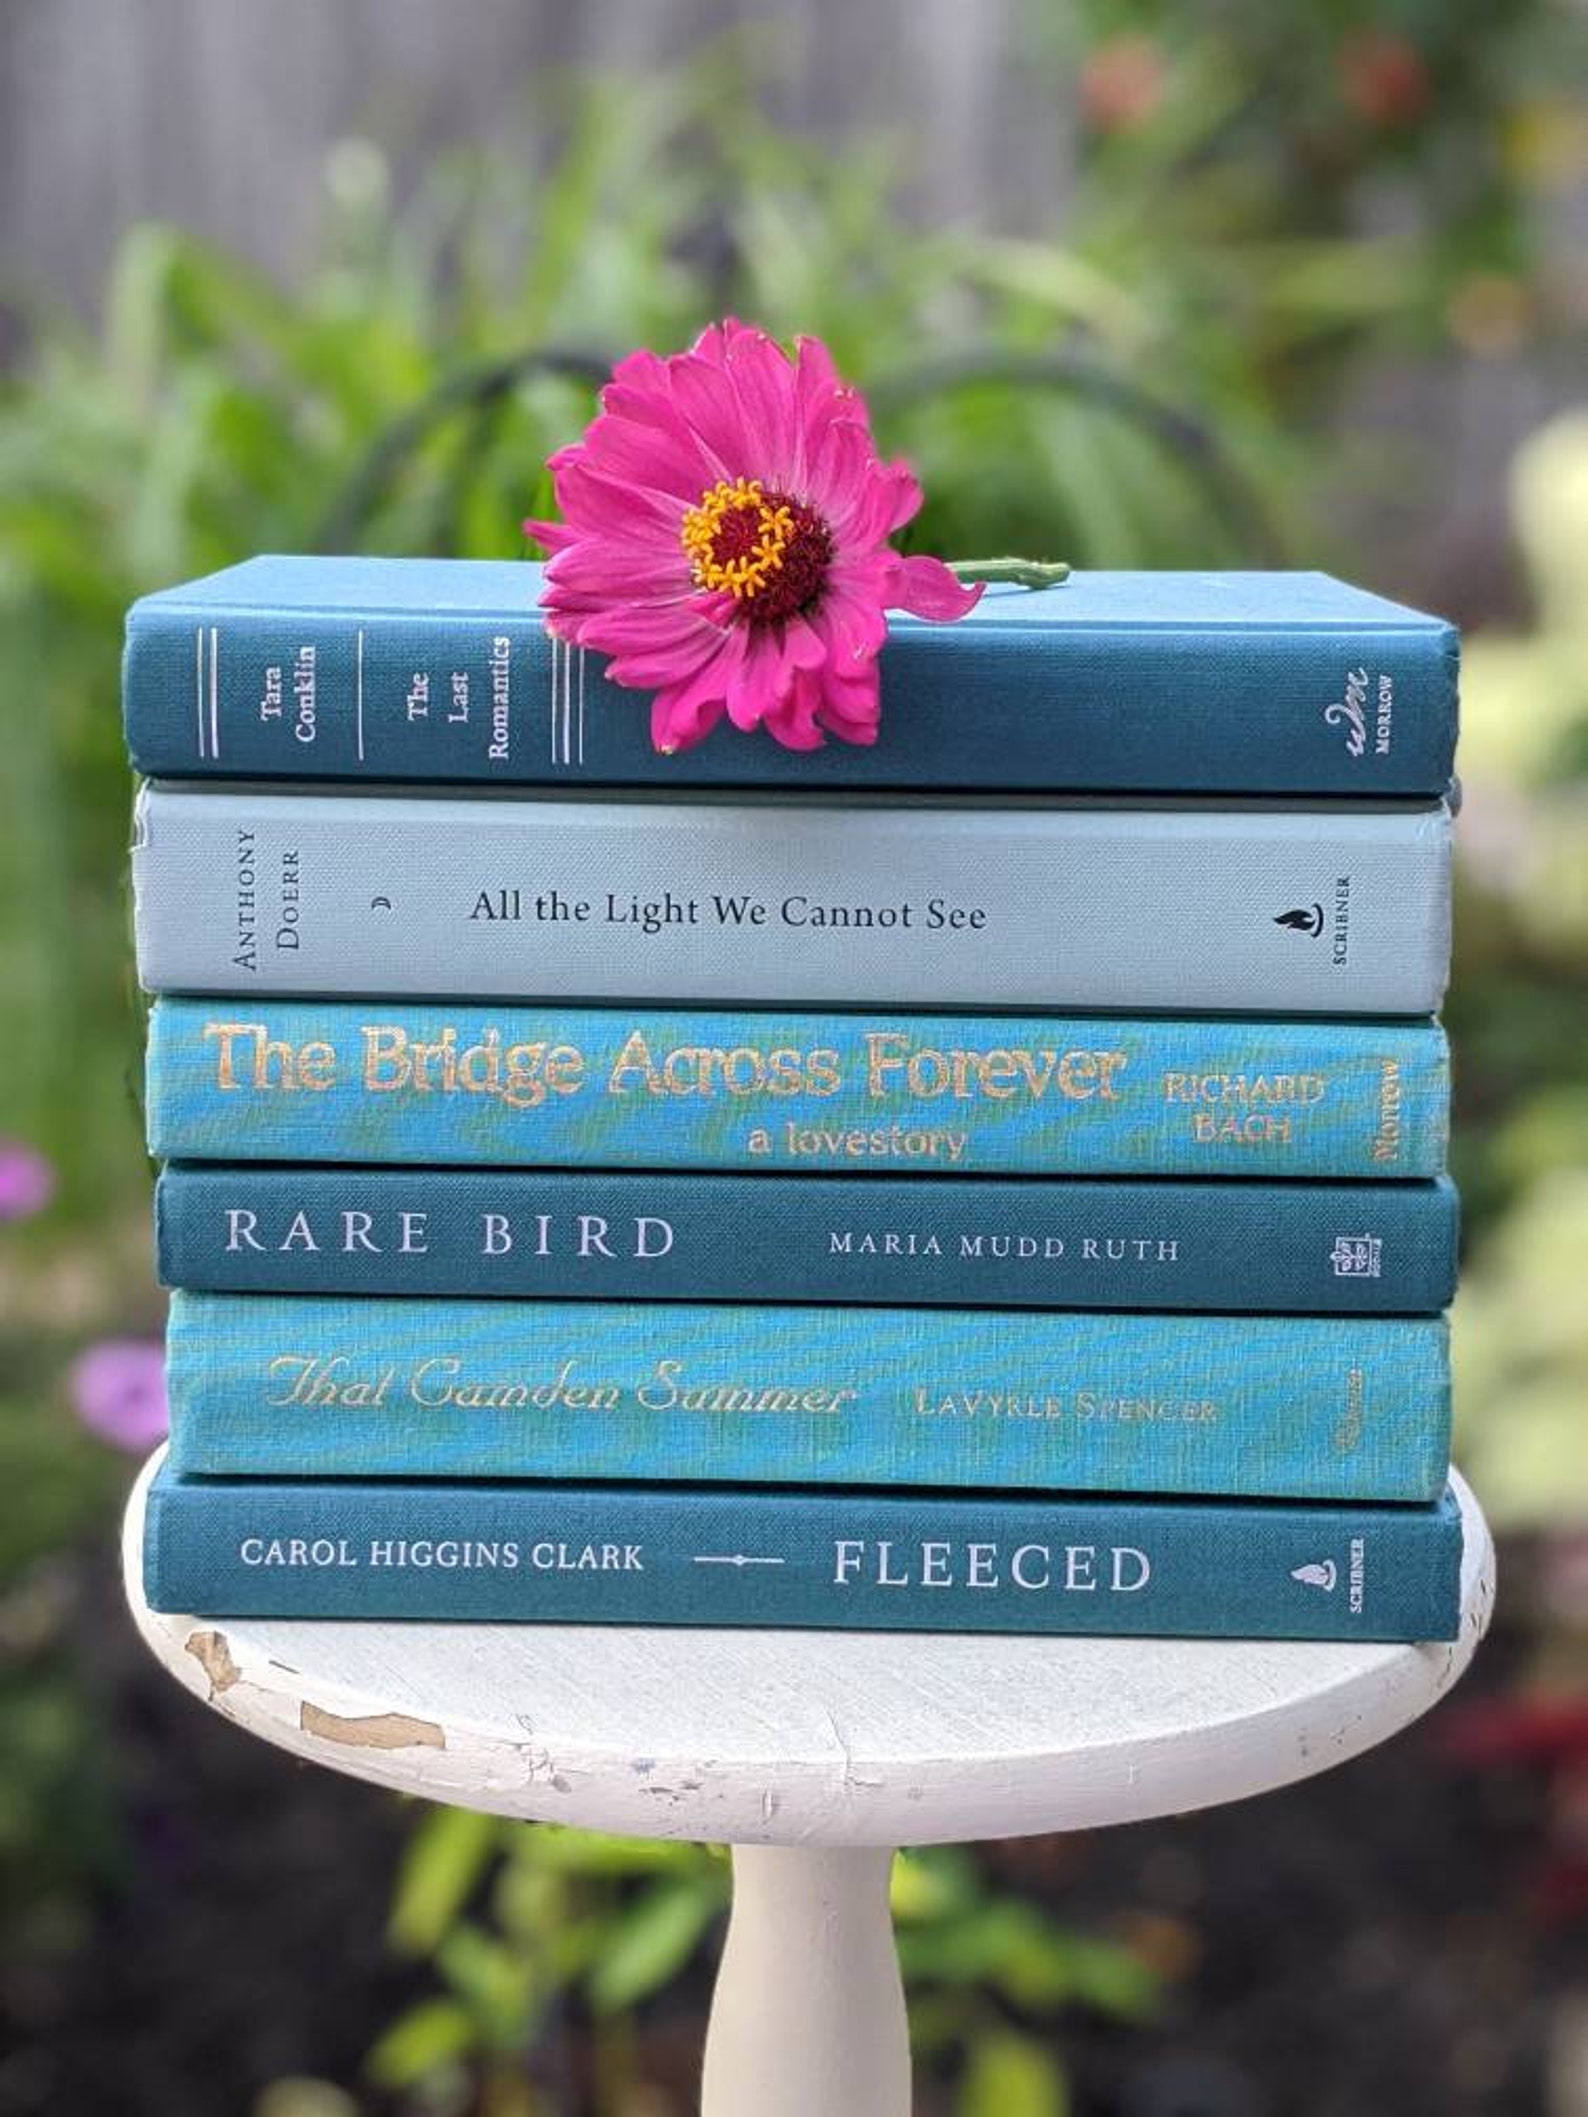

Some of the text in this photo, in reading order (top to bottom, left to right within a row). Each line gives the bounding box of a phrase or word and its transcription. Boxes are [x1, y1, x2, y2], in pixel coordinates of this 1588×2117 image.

[260, 666, 282, 721] Tara
[295, 646, 316, 742] Conklin
[408, 672, 429, 721] The
[448, 671, 468, 722] Last
[488, 635, 511, 760] Romantics
[1375, 674, 1393, 754] MORROW
[232, 829, 256, 971] ANTHONY
[276, 850, 299, 950] DOERR
[469, 890, 988, 934] All the Light We Cannot See
[1333, 876, 1350, 965] SCRIBNER
[204, 1022, 1128, 1108] The Bridge Across Forever
[1163, 1073, 1327, 1104] RICHARD
[747, 1122, 969, 1161] a lovestory
[1193, 1112, 1292, 1144] BACH
[225, 1209, 674, 1258] RARE BIRD
[829, 1232, 1179, 1261] MARIA MUDD RUTH
[268, 1355, 857, 1414] That Camden Summer
[1076, 1391, 1218, 1423] SPENCER
[240, 1538, 645, 1571] CAROL HIGGINS CLARK
[833, 1540, 1151, 1593] FLEECED
[1350, 1538, 1365, 1614] SCRIBNER
